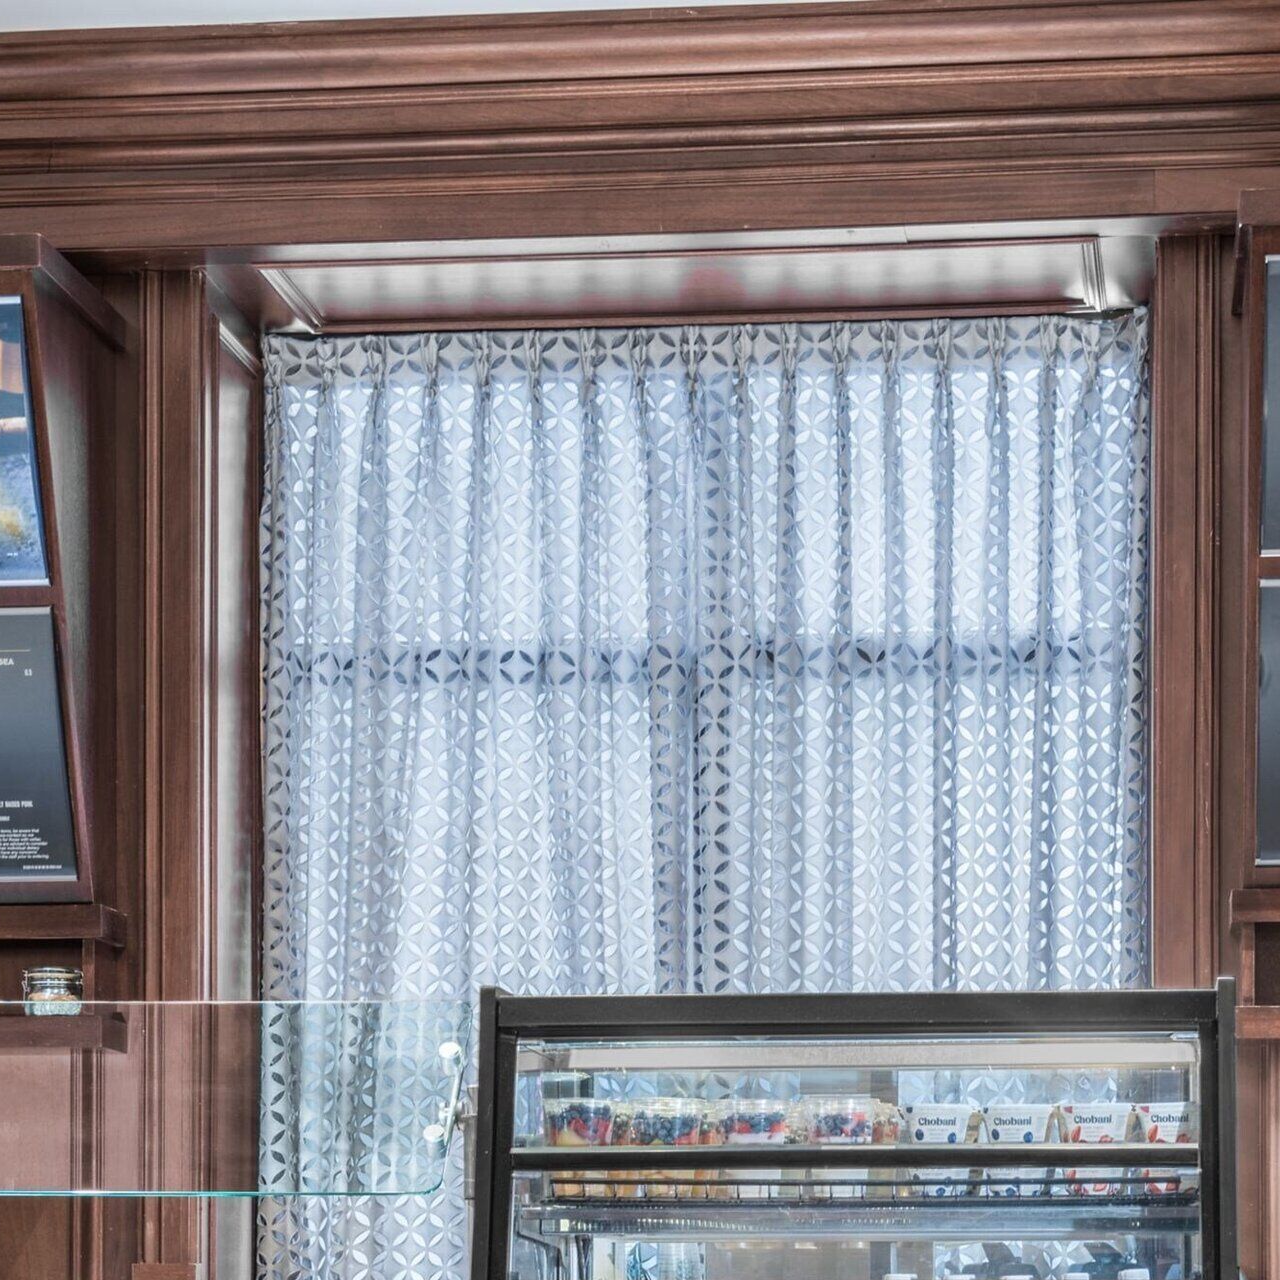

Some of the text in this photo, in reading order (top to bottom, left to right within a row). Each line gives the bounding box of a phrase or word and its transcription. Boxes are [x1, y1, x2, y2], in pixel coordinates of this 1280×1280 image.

[918, 1117, 957, 1126] Chobani
[993, 1116, 1032, 1126] Chobani
[1073, 1115, 1112, 1124] Chobani
[1151, 1114, 1189, 1123] Chobani
